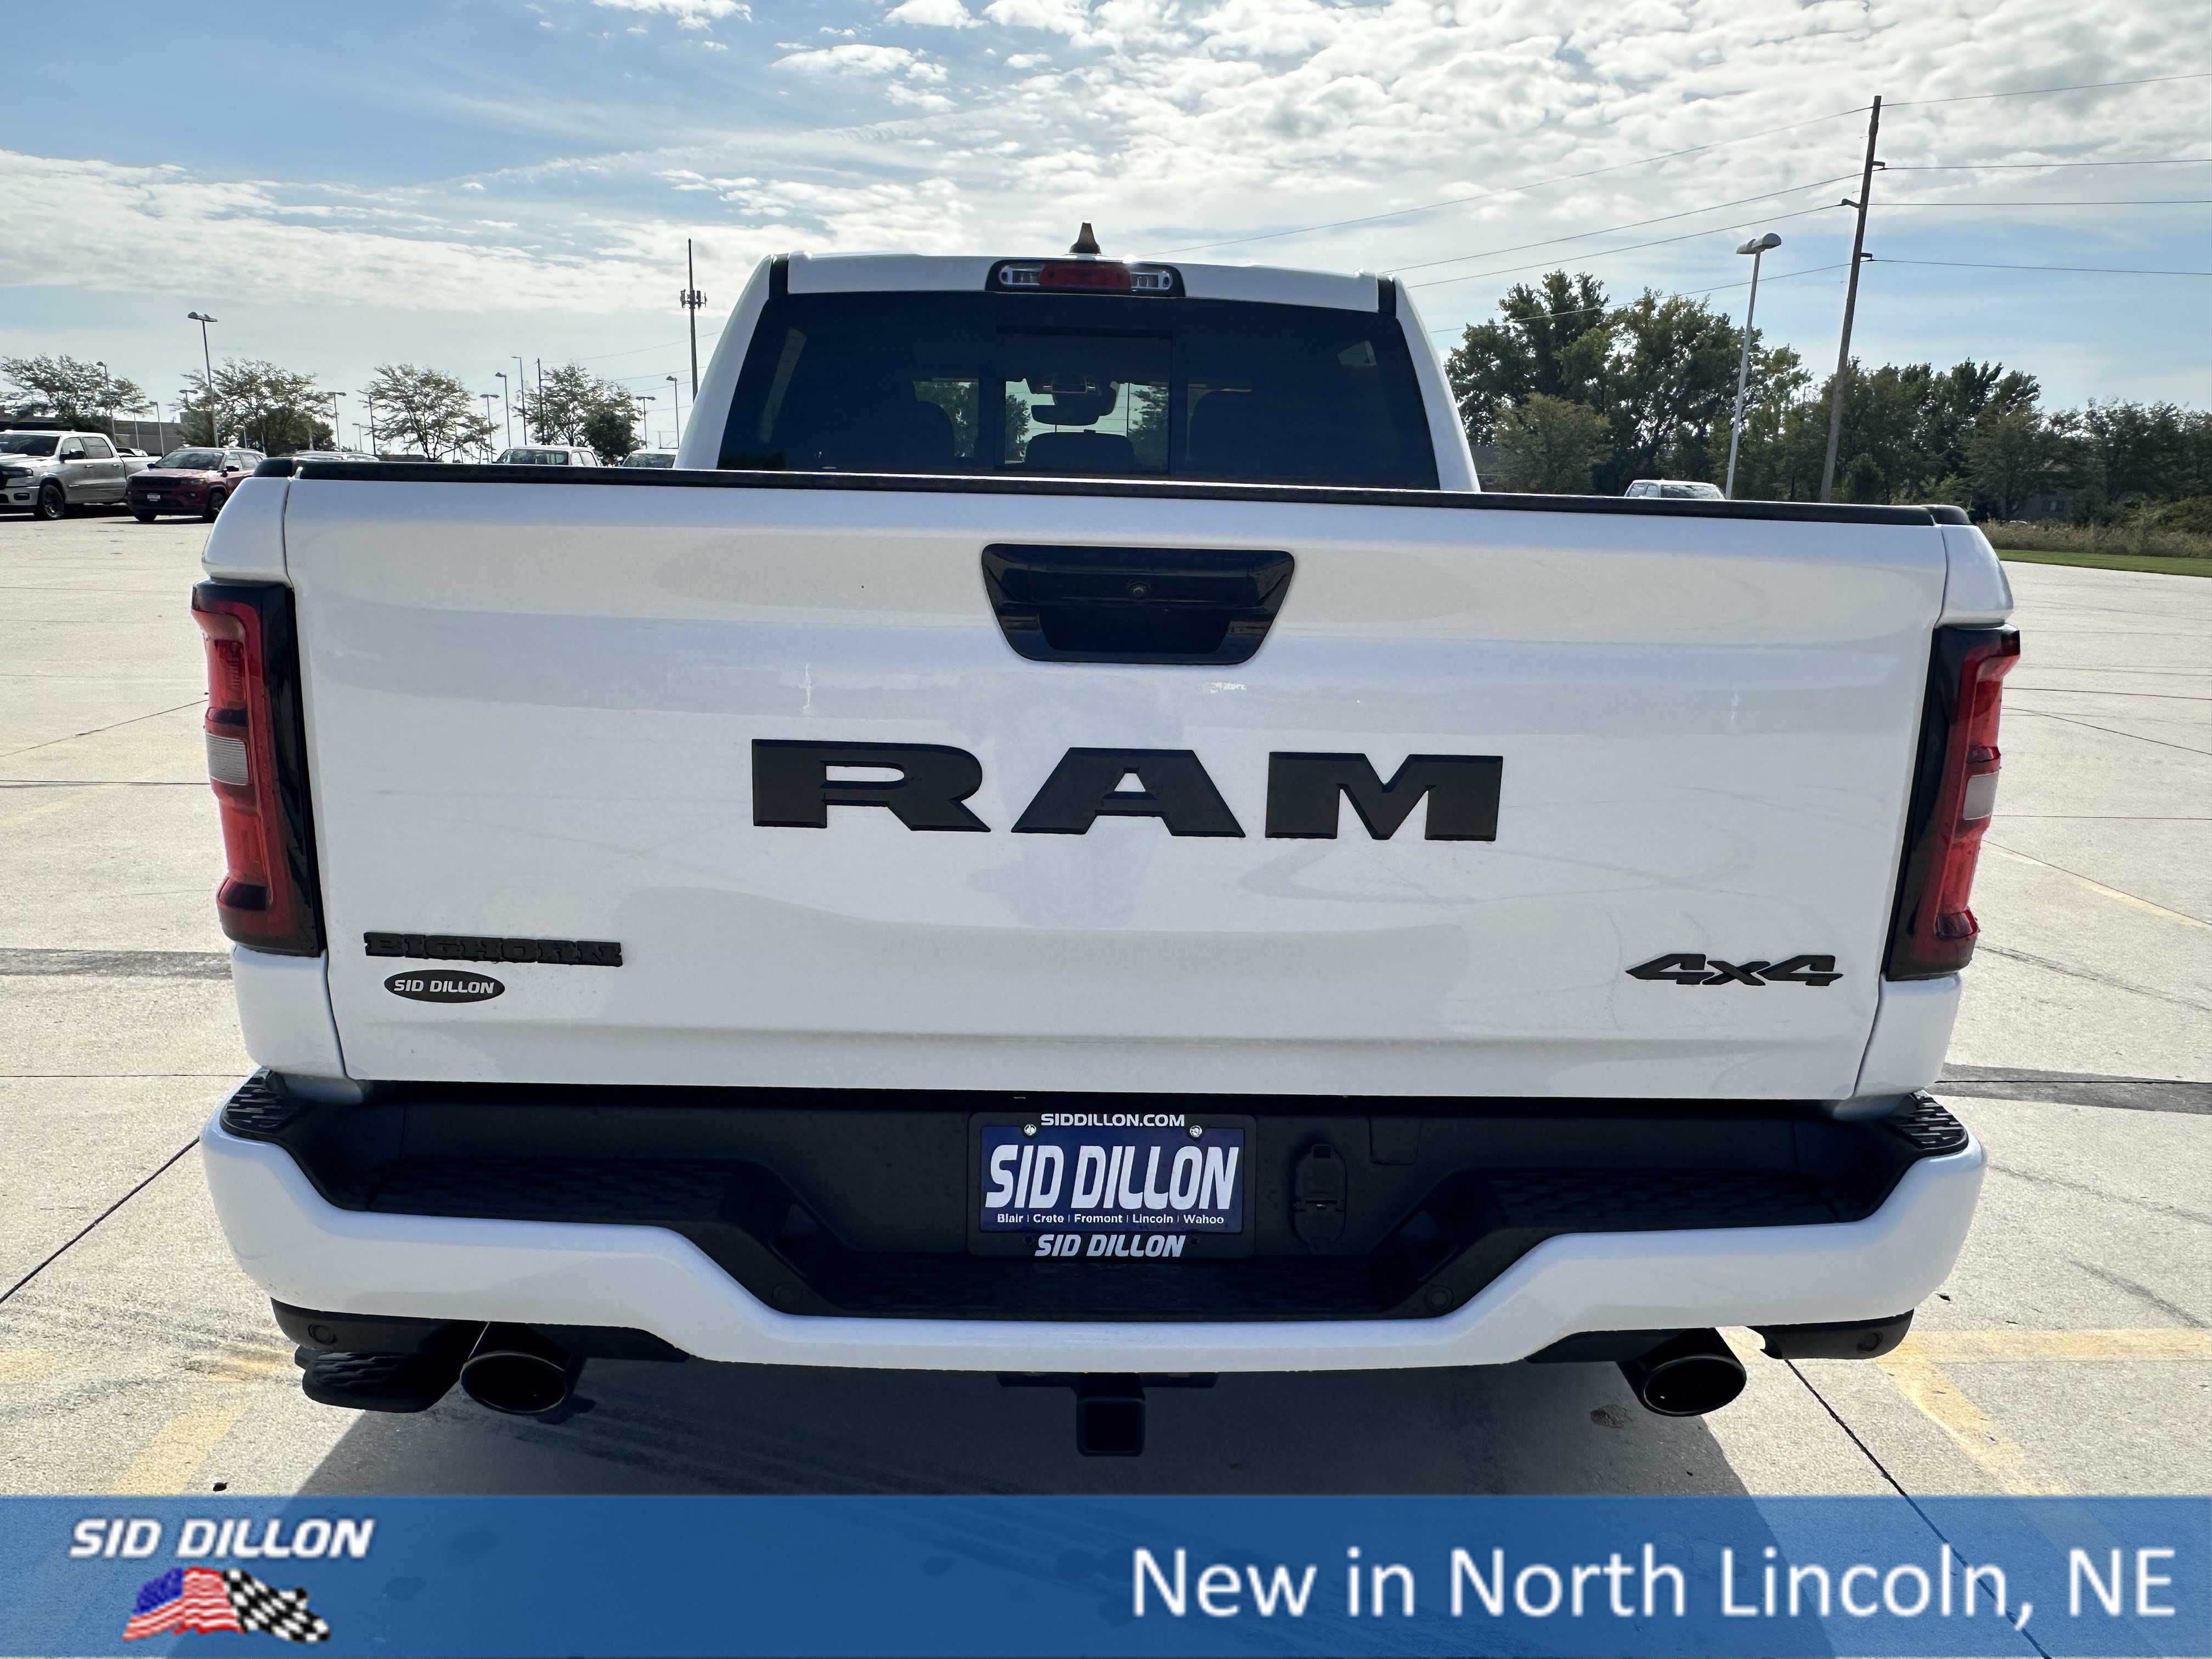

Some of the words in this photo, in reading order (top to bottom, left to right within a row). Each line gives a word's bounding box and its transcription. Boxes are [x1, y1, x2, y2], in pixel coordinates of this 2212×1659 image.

[752, 739, 1504, 842] RAM
[1625, 953, 1844, 987] 4x4
[393, 979, 424, 992] SID
[430, 980, 494, 994] DILLON
[1041, 1113, 1185, 1127] SIDDILLON.COM
[985, 1144, 1064, 1209] SID
[1070, 1146, 1239, 1210] DILLON
[997, 1213, 1024, 1223] Blair
[1074, 1214, 1123, 1223] Fremont
[1132, 1214, 1173, 1224] Lincoln
[1183, 1214, 1224, 1224] Wahoo
[1035, 1234, 1081, 1256] SID
[1086, 1234, 1186, 1257] DILLON
